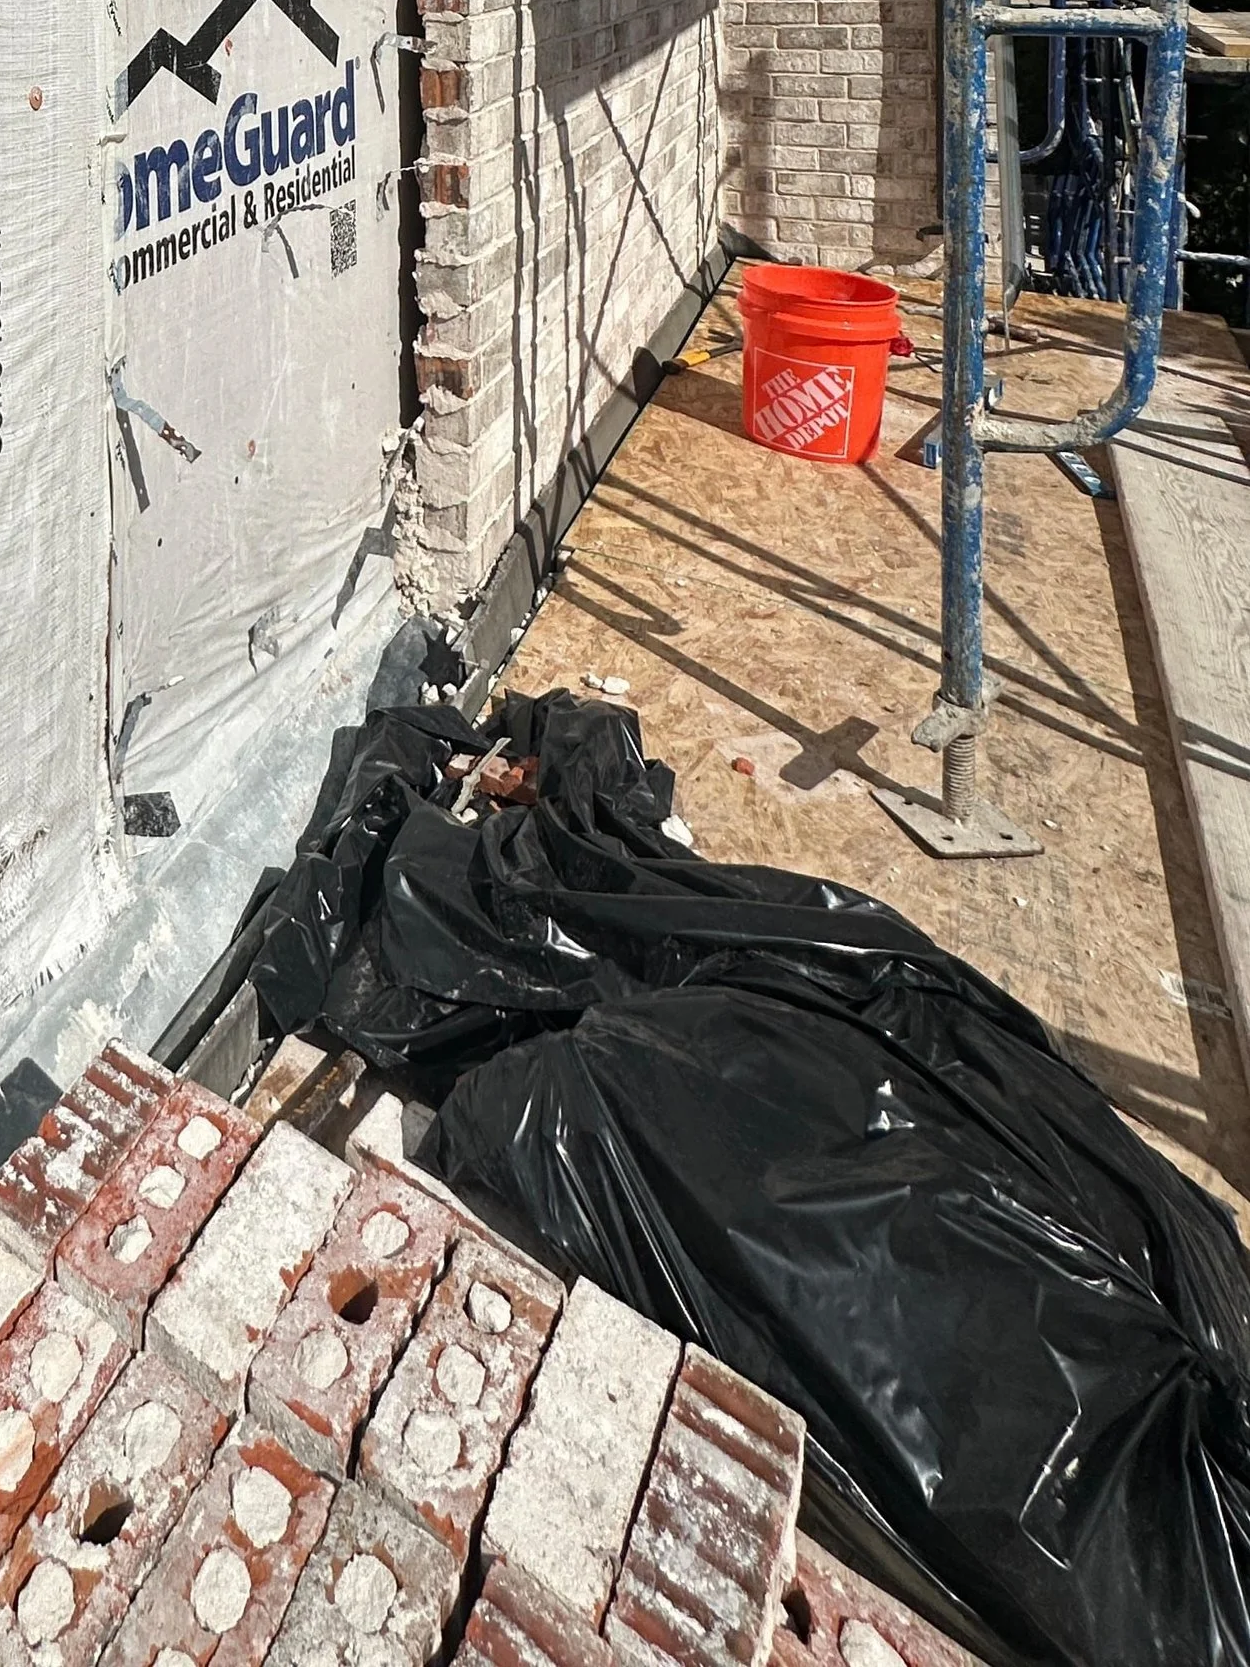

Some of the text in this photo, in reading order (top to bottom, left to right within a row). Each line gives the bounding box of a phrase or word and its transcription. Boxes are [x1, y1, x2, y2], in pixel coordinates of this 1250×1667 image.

[116, 194, 237, 291] ommercial
[243, 189, 259, 230] &
[263, 144, 356, 221] Residential
[753, 365, 852, 443] HOME
[761, 367, 802, 400] THE
[784, 400, 849, 450] DEPOT
